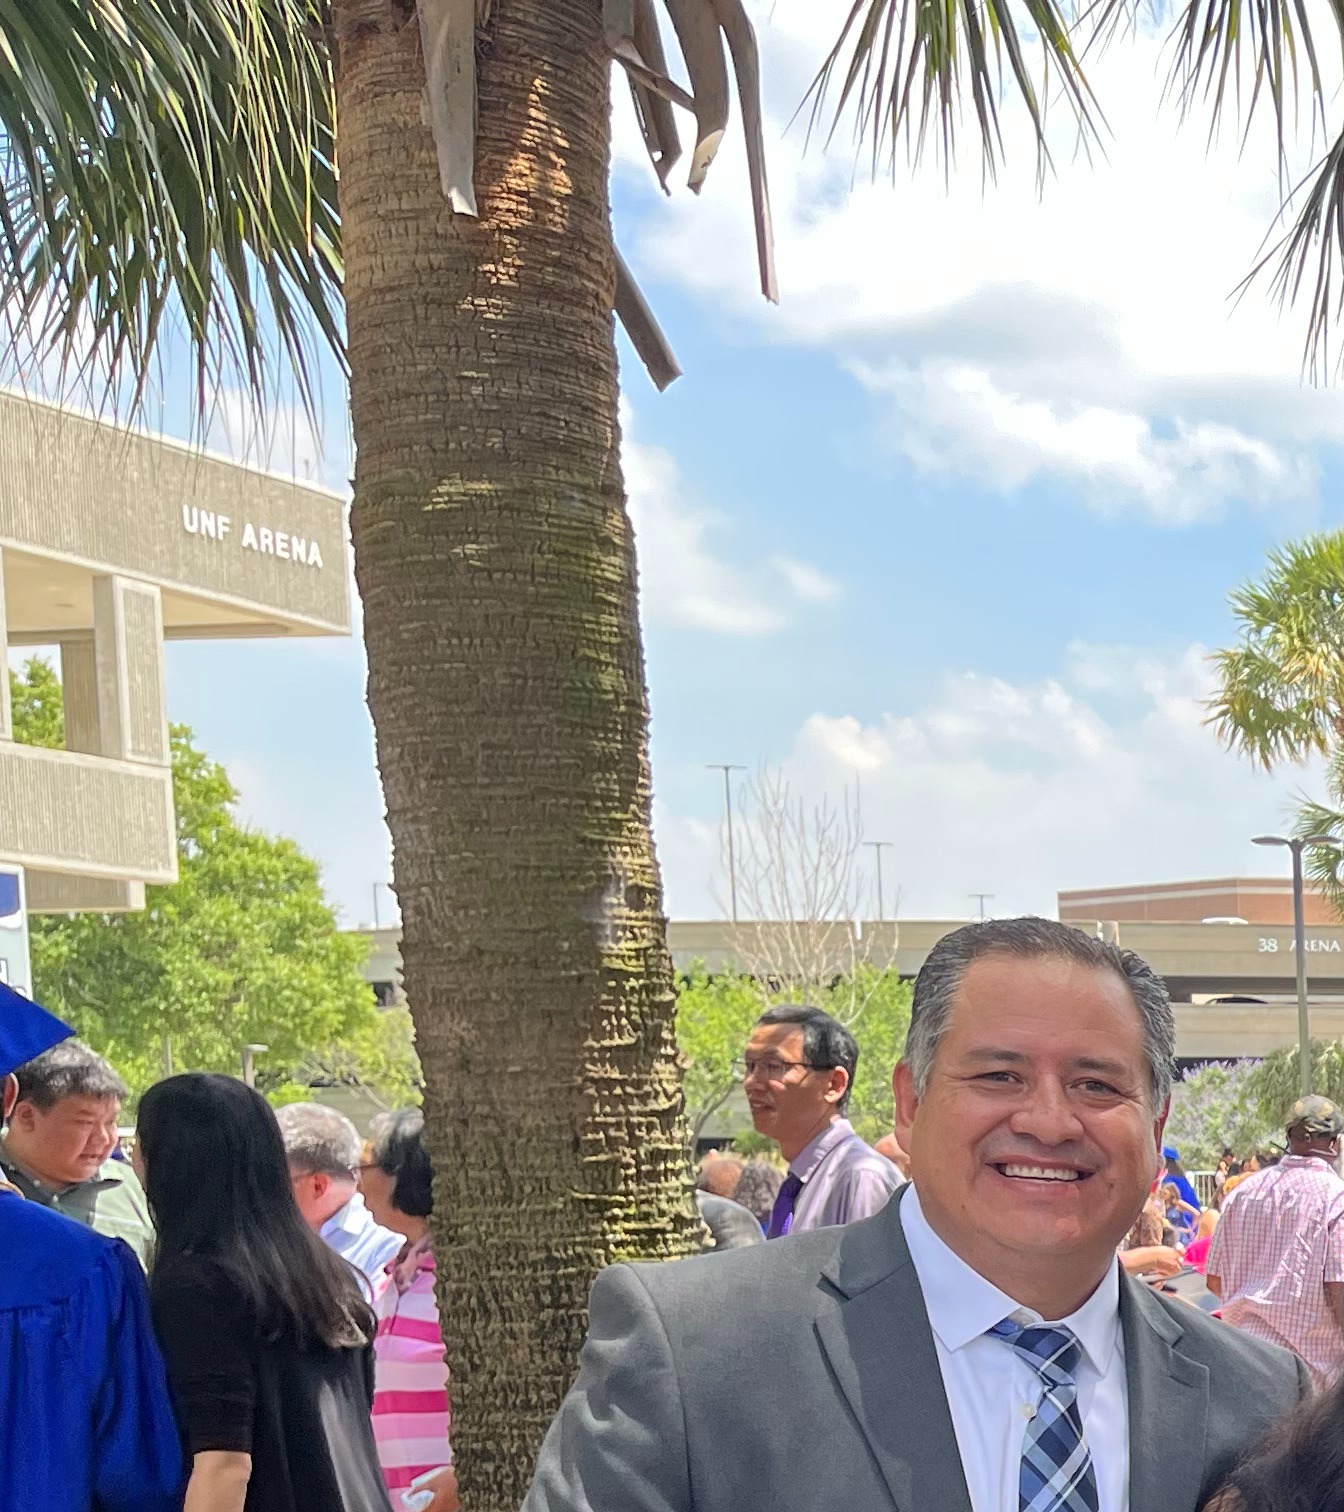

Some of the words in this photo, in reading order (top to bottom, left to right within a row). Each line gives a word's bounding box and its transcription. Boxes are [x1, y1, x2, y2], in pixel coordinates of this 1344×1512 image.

[182, 504, 230, 541] UNF
[241, 522, 324, 569] ARENA
[1258, 938, 1278, 953] 38
